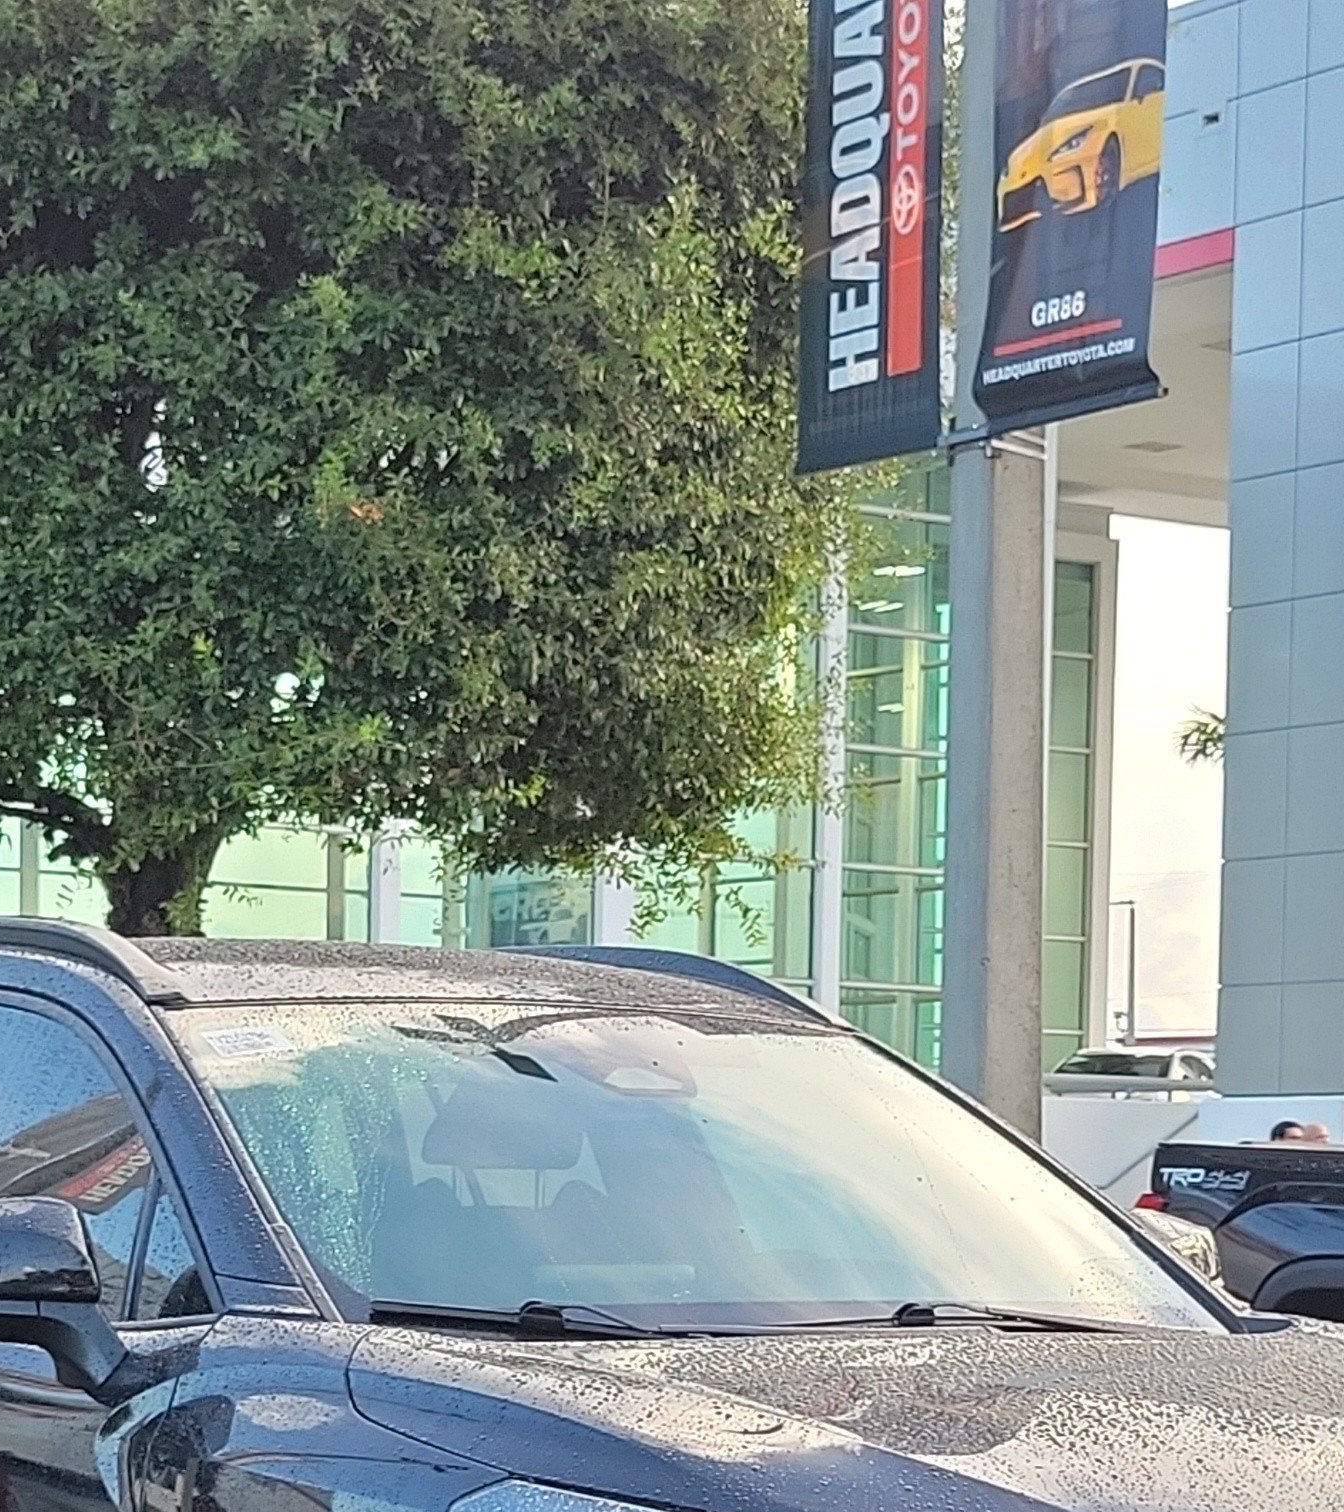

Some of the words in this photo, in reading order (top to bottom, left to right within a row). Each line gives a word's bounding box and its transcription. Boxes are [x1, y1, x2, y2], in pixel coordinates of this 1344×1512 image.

[896, 0, 922, 162] TOYO
[1031, 289, 1086, 328] GR86
[982, 337, 1136, 386] HEADQUARTERTOYOTA.COM
[1159, 1167, 1205, 1187] TRD
